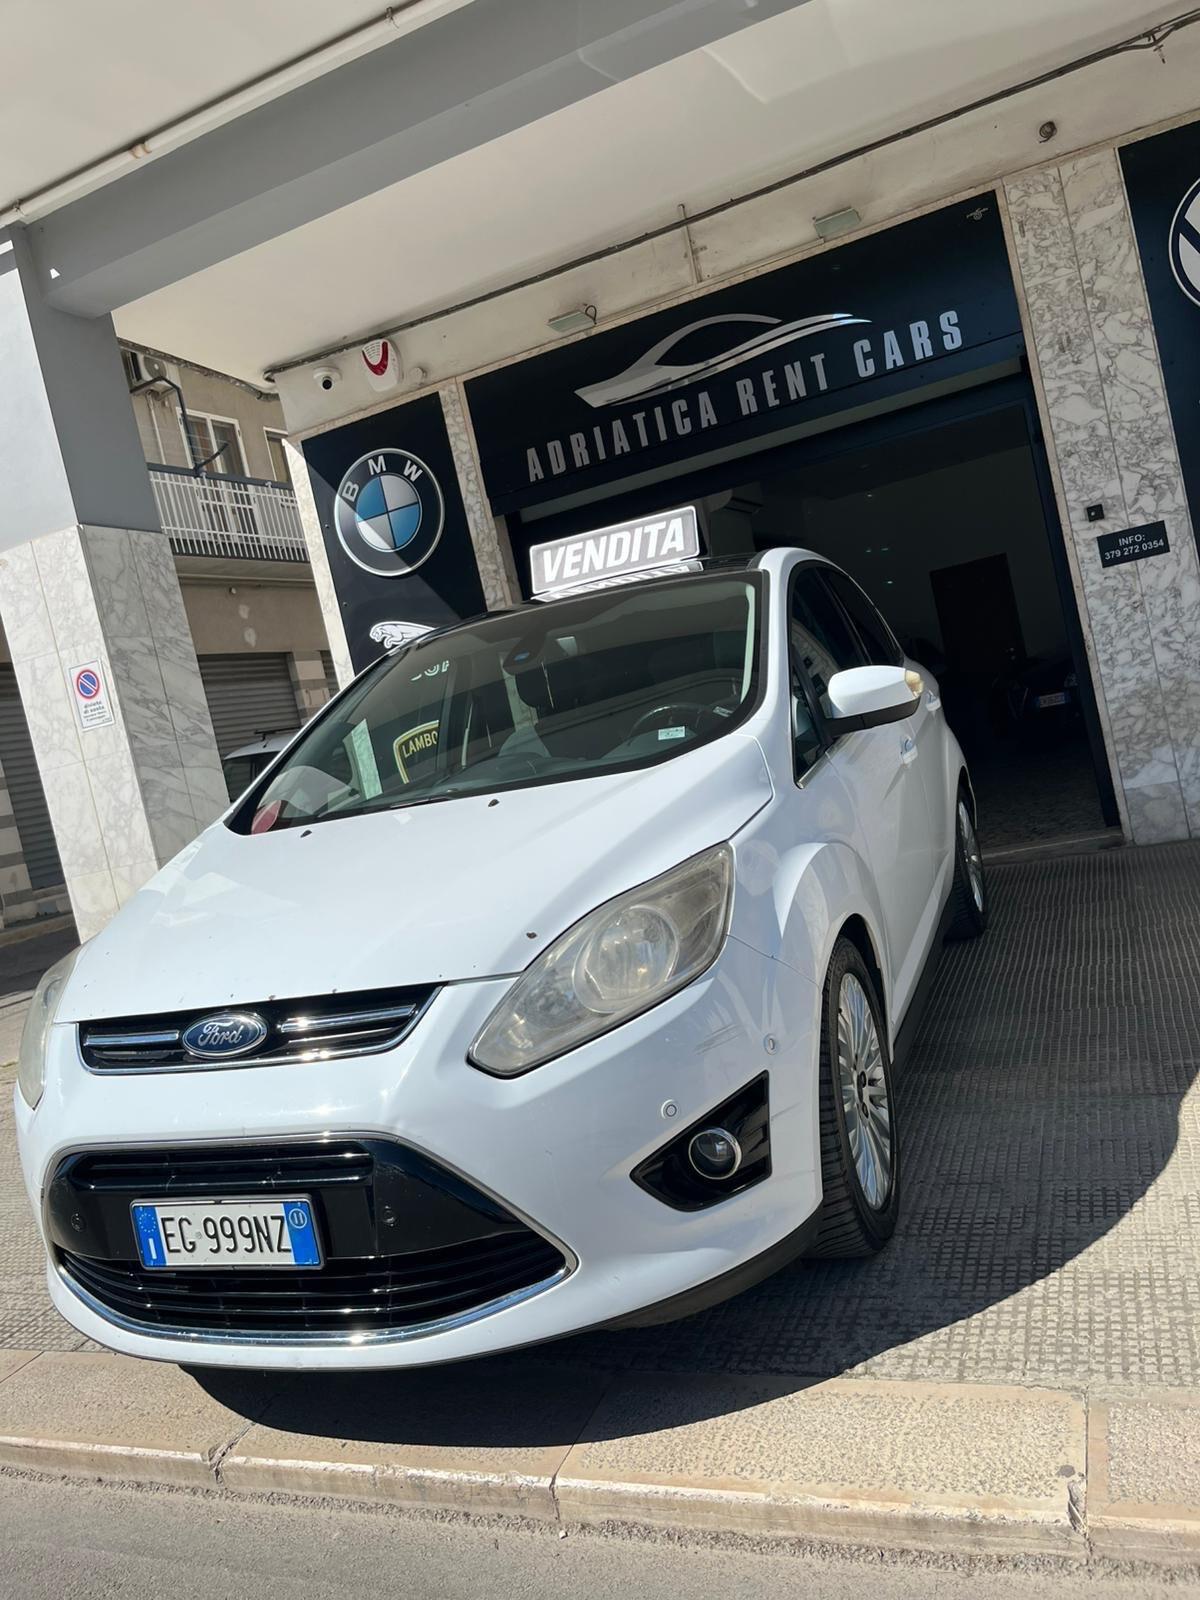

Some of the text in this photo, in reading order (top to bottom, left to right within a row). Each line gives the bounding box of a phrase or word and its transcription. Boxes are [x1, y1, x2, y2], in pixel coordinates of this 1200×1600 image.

[526, 309, 963, 483] ADRIATICA RENT CARS
[341, 455, 423, 502] BMW
[542, 517, 685, 583] VENDITA
[1104, 538, 1164, 560] 379 272 0354
[1118, 533, 1146, 547] INFO:
[197, 1020, 245, 1047] Ford
